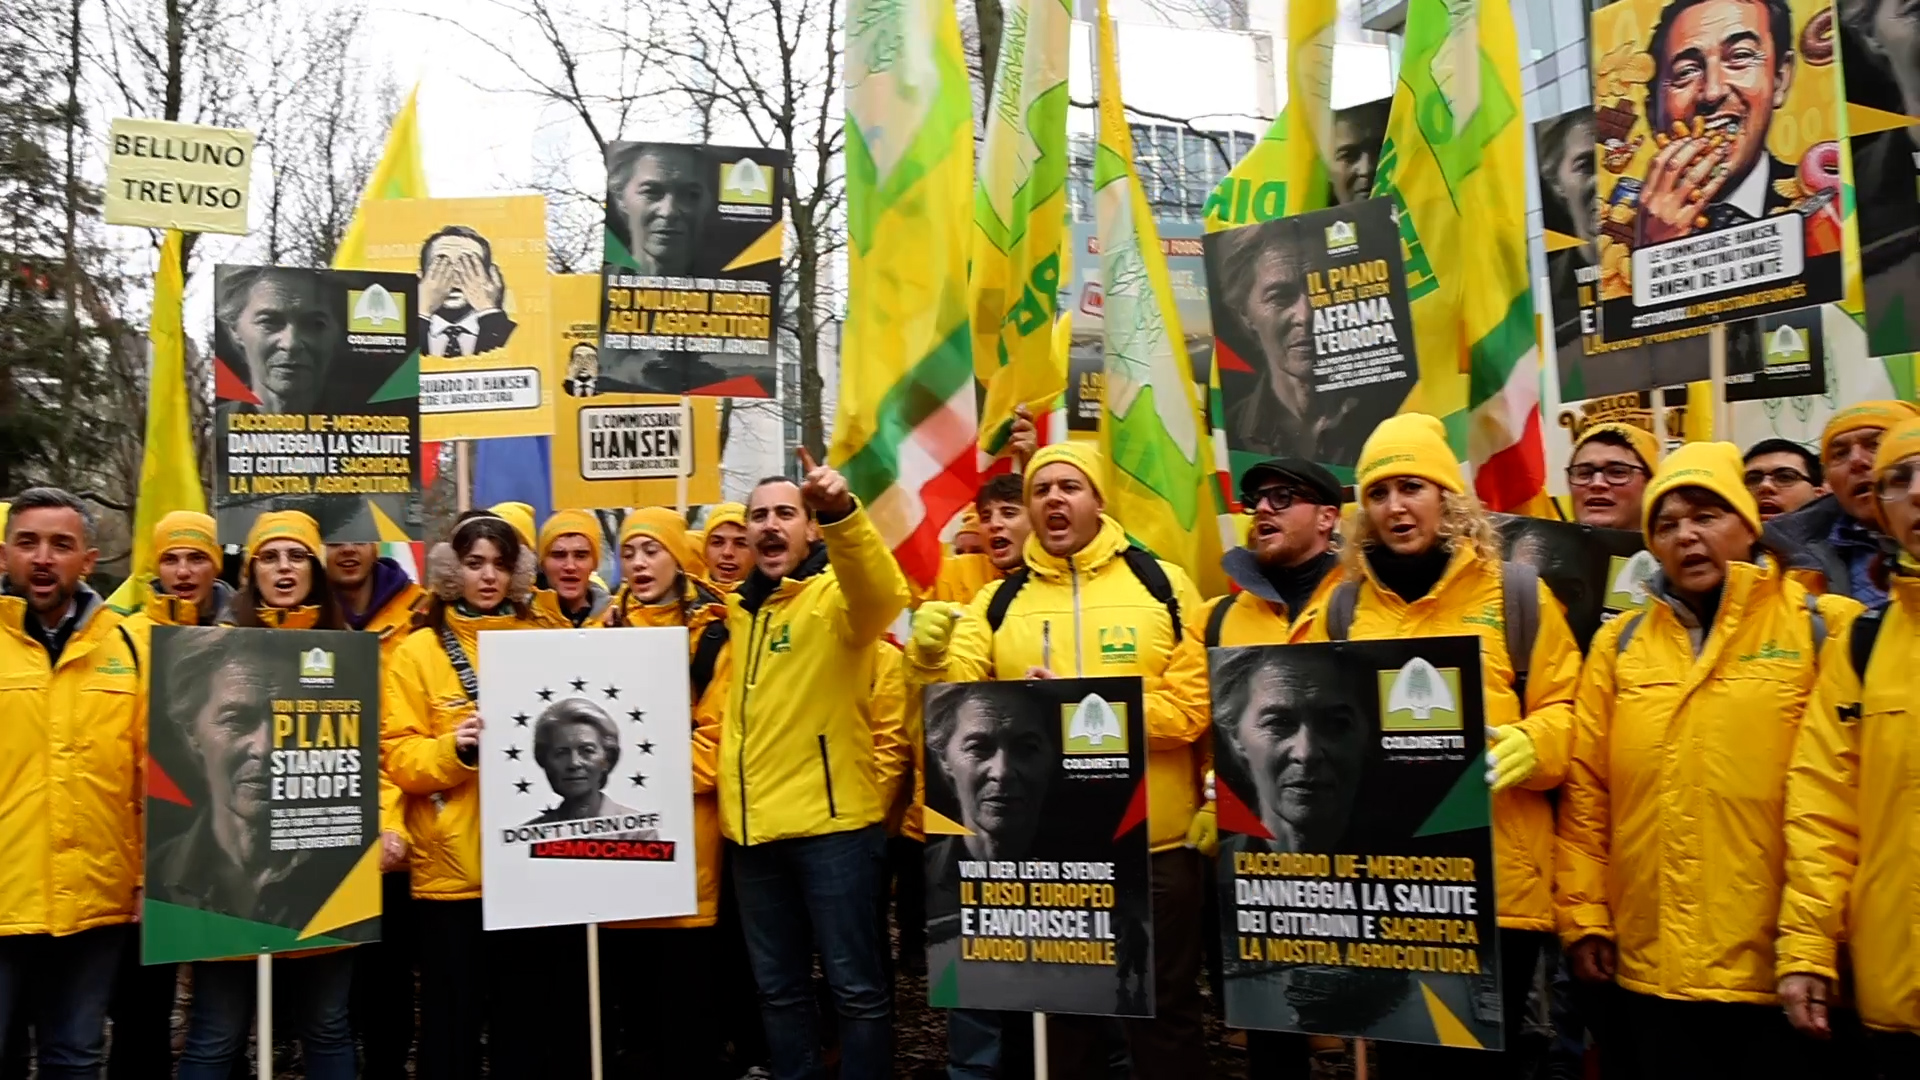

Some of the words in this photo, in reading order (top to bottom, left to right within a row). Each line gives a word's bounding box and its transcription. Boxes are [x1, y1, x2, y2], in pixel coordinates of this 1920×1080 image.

[115, 134, 244, 167] BELLUNO
[121, 178, 241, 208] TREVISO
[1650, 250, 1661, 263] LE
[1664, 234, 1731, 260] COMMISSAIRE
[1307, 272, 1327, 294] IL
[1328, 260, 1388, 290] PIANO
[1574, 266, 1600, 283] VO
[1651, 276, 1696, 298] ENNEMI
[1702, 272, 1716, 288] DE
[1721, 267, 1736, 283] LA
[1652, 266, 1666, 278] AMI
[1671, 261, 1687, 274] DES
[608, 288, 631, 309] 90
[634, 290, 708, 312] MILIARDI
[712, 292, 770, 314] RUBATI
[1308, 294, 1332, 308] VON
[1334, 289, 1356, 303] DER
[1357, 282, 1390, 298] LEYEN
[607, 310, 648, 333] AGLI
[652, 312, 769, 338] AGRICOLTORI
[1312, 297, 1394, 333] AFFAMA
[1580, 309, 1595, 333] E
[604, 334, 630, 349] PER
[630, 335, 675, 350] BOMBE
[676, 336, 684, 350] E
[1314, 322, 1397, 354] L'EUROPA
[420, 378, 462, 392] GUARDO
[466, 378, 479, 390] DI
[482, 376, 531, 390] HANSEN
[228, 414, 306, 431] L'ACCORDO
[308, 414, 410, 432] UE-MERCOSUR
[588, 415, 600, 428] IL
[228, 434, 324, 454] DANNEGGIA
[328, 434, 349, 454] LA
[351, 435, 410, 454] SALUTE
[591, 430, 680, 458] HANSEN
[228, 456, 253, 473] DEI
[256, 456, 325, 473] CITTADINI
[328, 457, 338, 473] E
[340, 457, 411, 474] SACRIFICA
[229, 476, 249, 494] LA
[252, 476, 311, 494] NOSTRA
[315, 476, 410, 494] AGRICOLTURA
[271, 700, 295, 712] VON
[296, 700, 318, 712] DER
[273, 714, 360, 748] PLAN
[1381, 736, 1464, 749] COLDIRETTI
[270, 749, 362, 775] STARVES
[1062, 758, 1129, 769] COLDIRETTI
[271, 775, 362, 800] EUROPE
[504, 824, 564, 843] DON'T
[568, 818, 619, 836] TURN
[624, 814, 660, 829] OFF
[536, 842, 673, 858] DEMOCRACY
[958, 860, 986, 878] VON
[989, 861, 1016, 878] DER
[1019, 862, 1059, 879] LEYEN
[1062, 862, 1115, 880] SVENDE
[1234, 852, 1330, 876] L'ACCORDO
[1334, 854, 1476, 882] UE-MERCOSUR
[960, 882, 978, 905] IL
[981, 882, 1025, 906] RISO
[1030, 883, 1115, 908] EUROPEO
[1235, 879, 1358, 910] DANNEGGIA
[1361, 882, 1390, 912] LA
[1394, 884, 1478, 915] SALUTE
[961, 908, 974, 935] E
[979, 909, 1089, 938] FAVORISCE
[1094, 911, 1115, 939] IL
[1237, 910, 1266, 933] DEI
[1270, 911, 1358, 938] CITTADINI
[1364, 916, 1376, 938] E
[1378, 916, 1479, 944] SACRIFICA
[962, 938, 1026, 961] LAVORO
[1032, 940, 1116, 965] MINORILE
[1238, 936, 1263, 961] LA
[1266, 938, 1342, 966] NOSTRA
[1346, 942, 1480, 974] AGRICOLTURA
